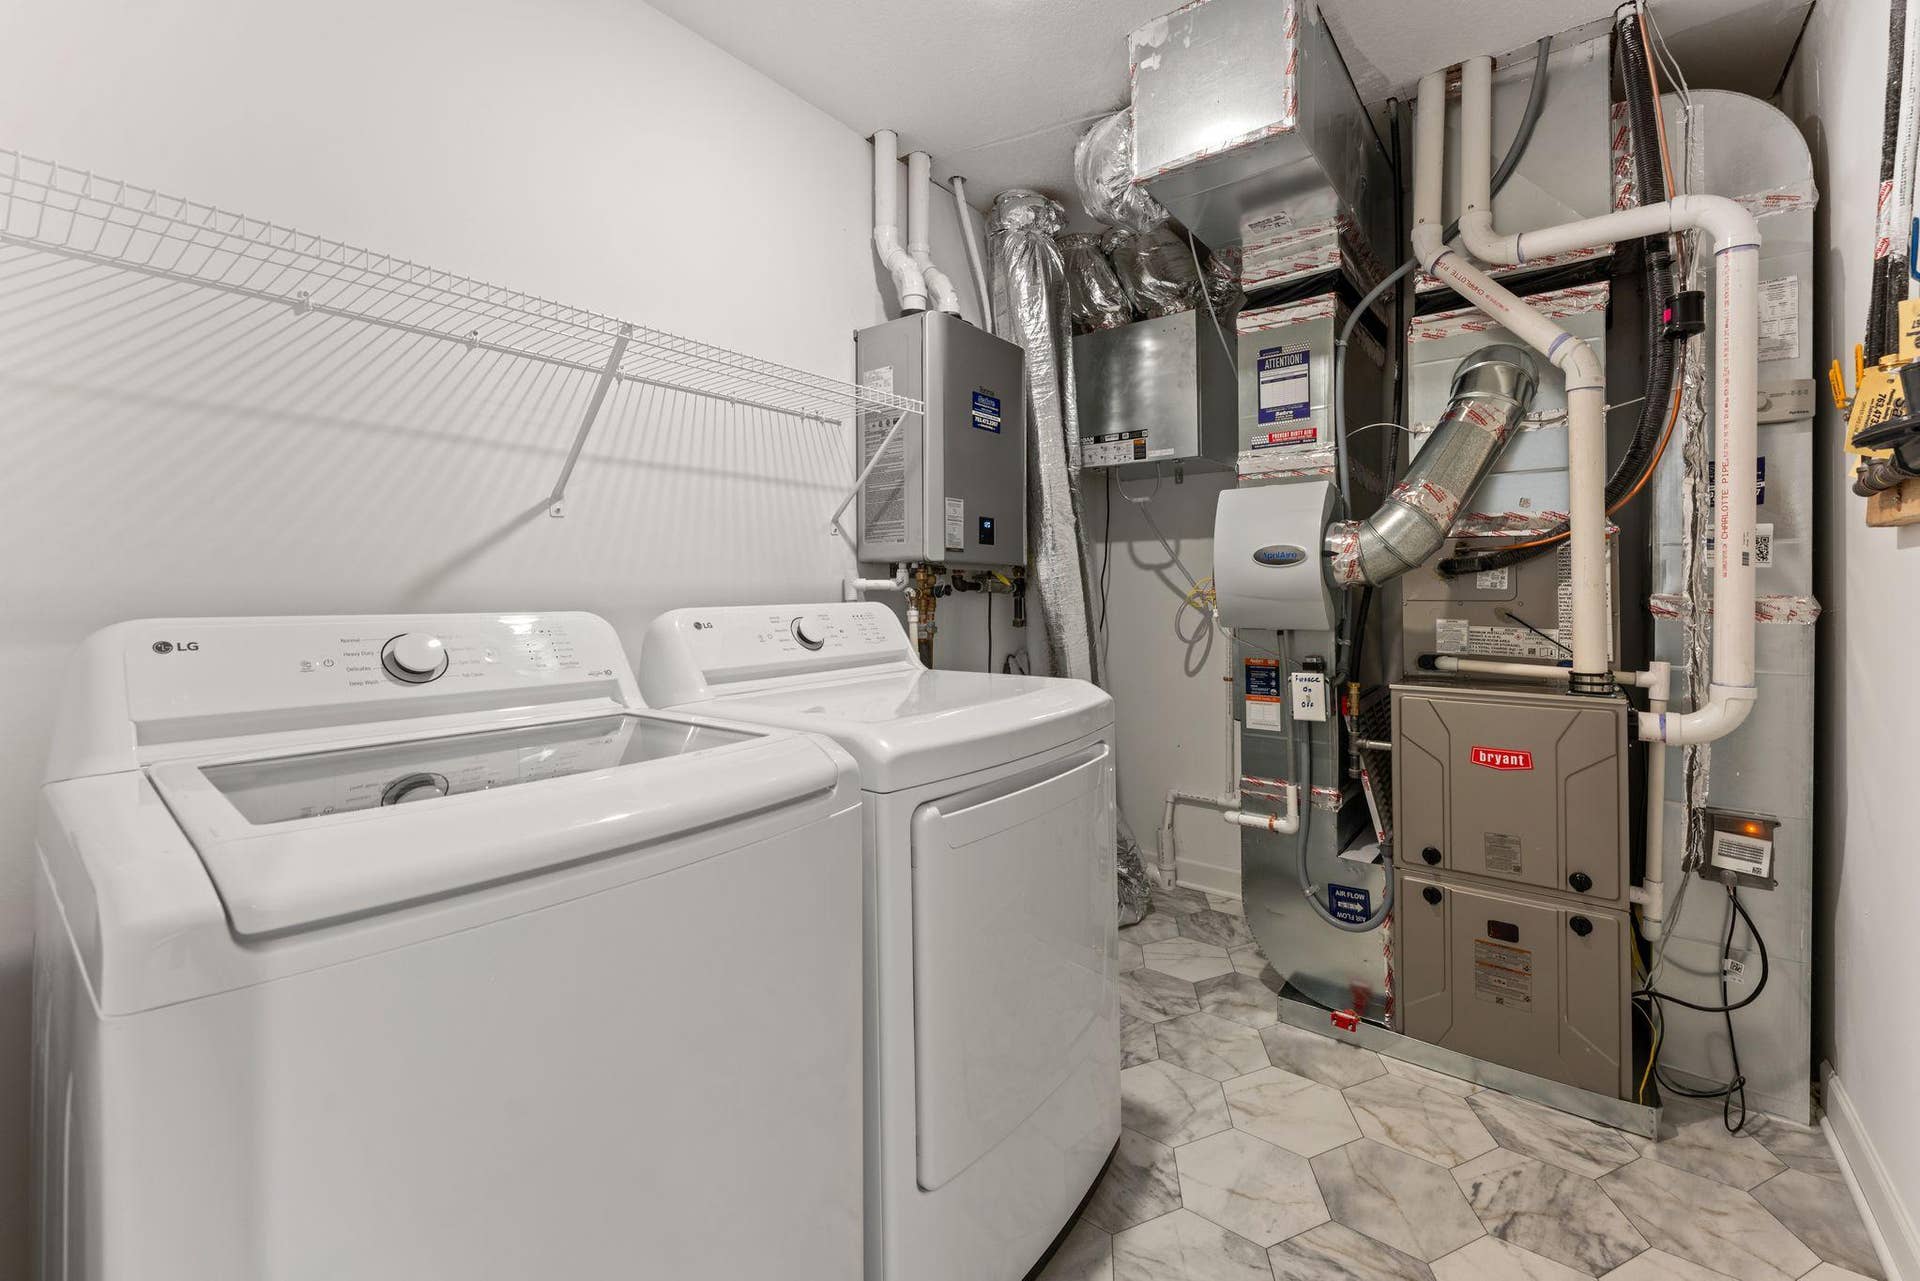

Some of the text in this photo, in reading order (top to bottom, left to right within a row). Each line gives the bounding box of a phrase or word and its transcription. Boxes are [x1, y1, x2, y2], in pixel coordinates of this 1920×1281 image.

[1264, 353, 1303, 370] ATTENTION!
[1721, 462, 1729, 484] PIPE
[1721, 489, 1729, 540] CHARLOTTE
[1479, 750, 1525, 767] bryant
[1335, 889, 1366, 900] AIR FLOW
